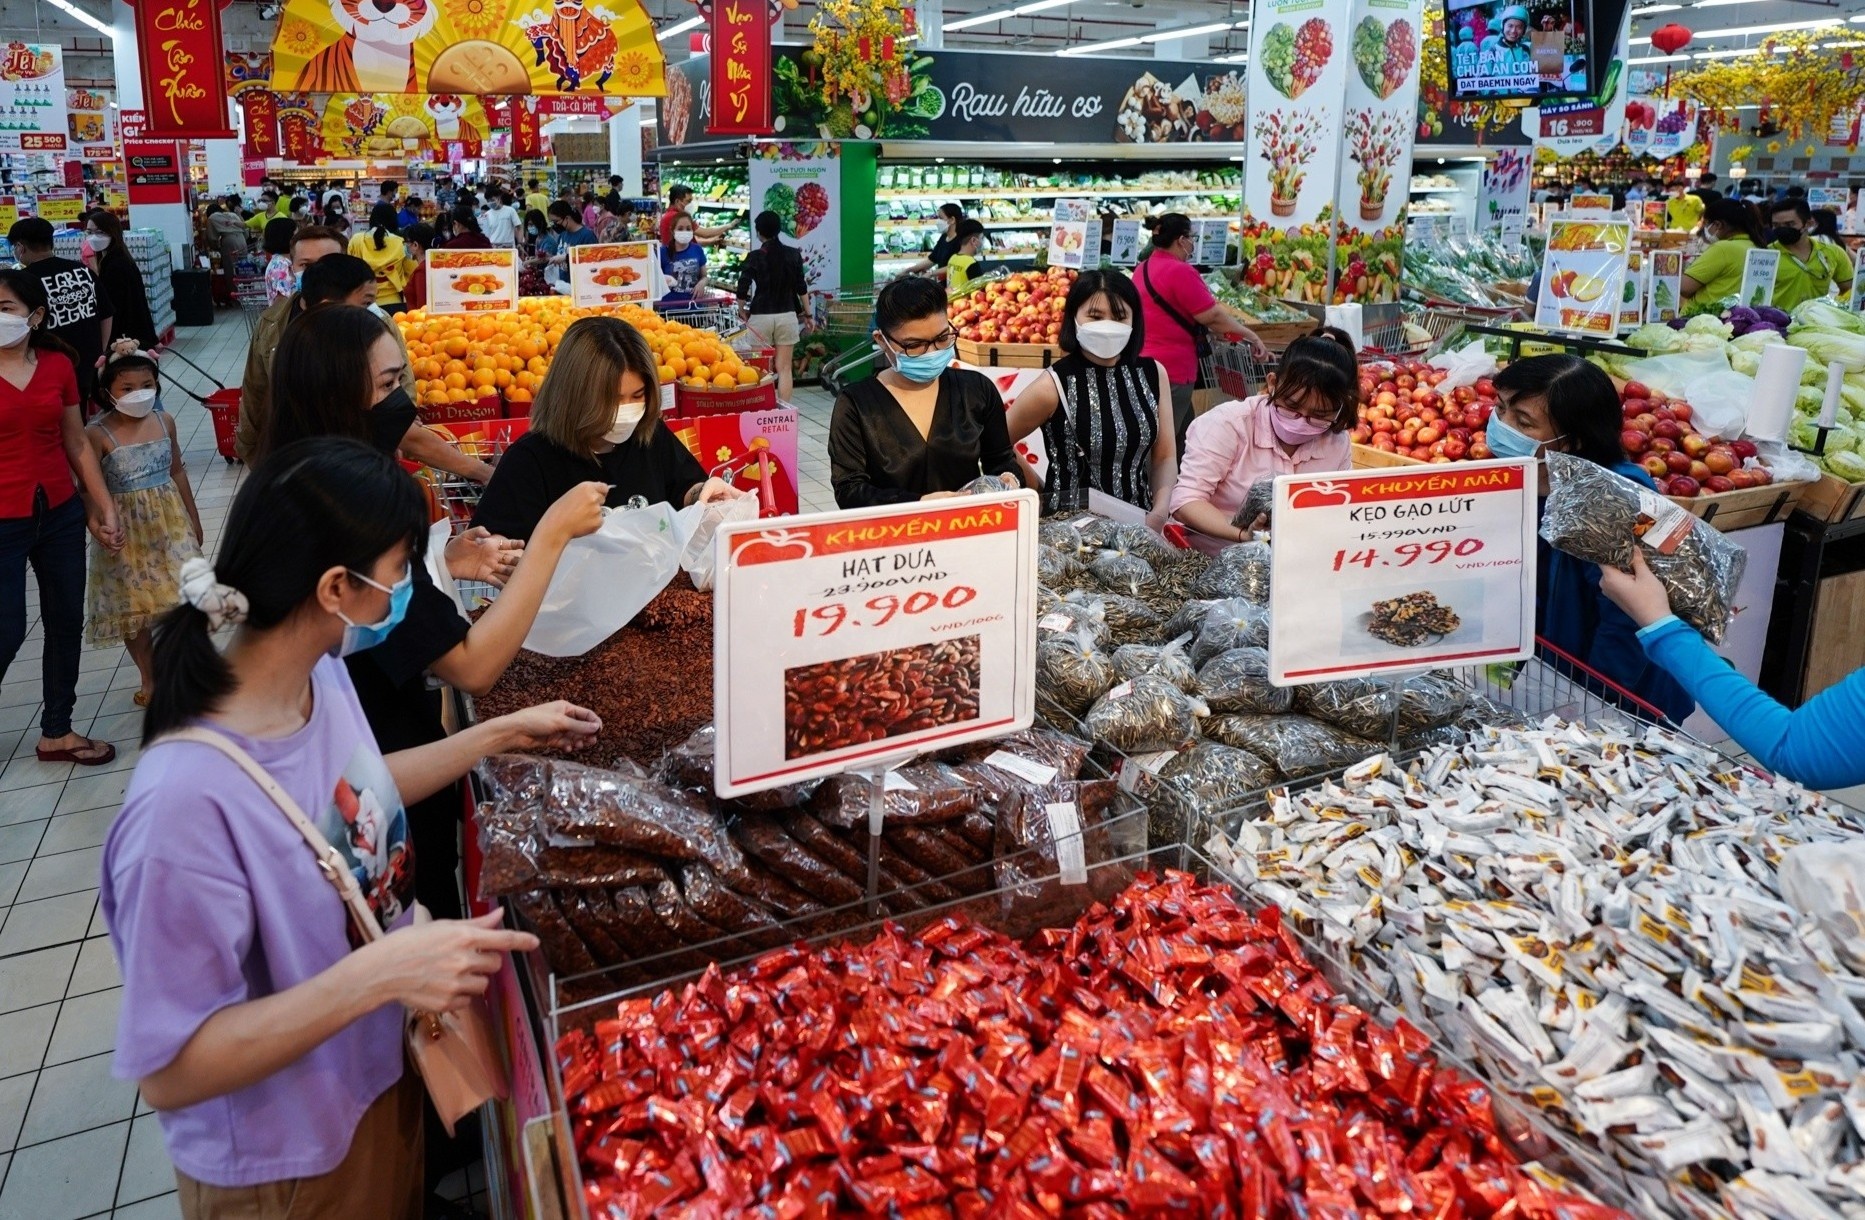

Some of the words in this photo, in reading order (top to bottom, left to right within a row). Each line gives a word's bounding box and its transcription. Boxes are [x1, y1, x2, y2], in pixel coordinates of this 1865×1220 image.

[155, 7, 206, 31] Chúc
[725, 0, 754, 26] Vạn
[731, 31, 748, 55] Sự
[1477, 79, 1511, 88] BAEMIN
[1513, 77, 1537, 86] NGAY
[729, 83, 751, 123] Ý
[951, 82, 1008, 122] Rau
[1011, 85, 1066, 118] hữu
[1071, 95, 1103, 118] cơ
[1548, 119, 1569, 137] 16
[23, 136, 43, 148] 25
[43, 135, 62, 143] 500
[446, 406, 497, 420] Dragon
[756, 415, 795, 426] CENTRAL
[762, 425, 790, 434] RETAIL
[1361, 474, 1458, 496] KHUYẾN
[1463, 470, 1510, 489] MÃI
[1349, 506, 1387, 525] KẸO
[1393, 502, 1433, 521] GẠO
[1438, 497, 1476, 514] LỨT
[825, 516, 942, 547] KHUYẾN
[948, 508, 1004, 531] MÃI
[1359, 524, 1458, 541] 15.990VND
[841, 555, 888, 581] HẠT
[893, 548, 937, 571] DƯA
[1332, 537, 1485, 572] 14.990
[822, 571, 949, 599] 23.900VND
[793, 585, 977, 638] 19.900
